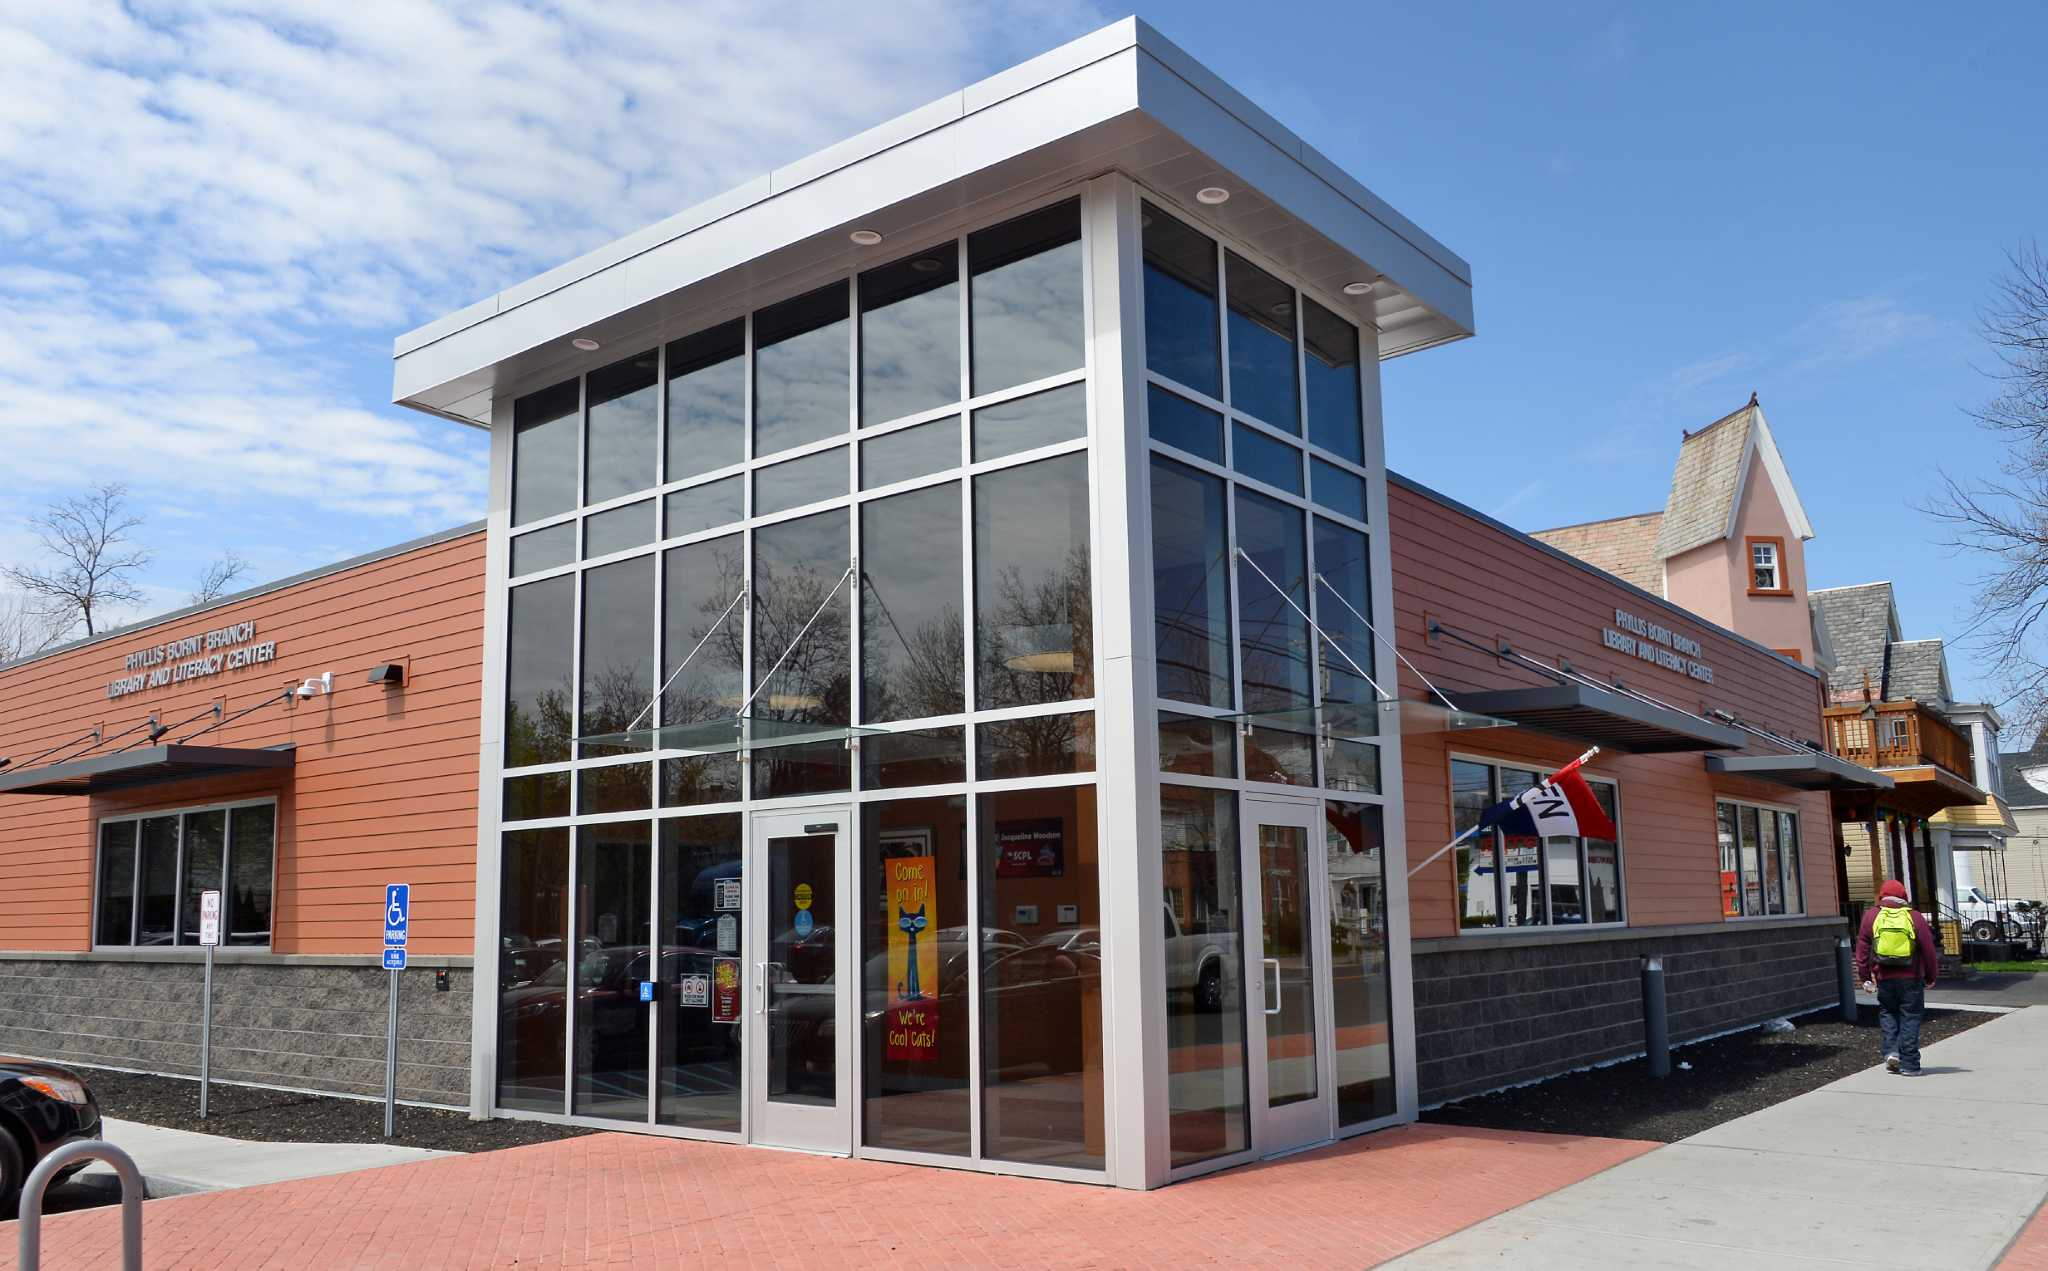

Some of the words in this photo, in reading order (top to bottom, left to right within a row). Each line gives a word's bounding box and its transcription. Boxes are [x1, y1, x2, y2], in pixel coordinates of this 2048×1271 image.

[1616, 609, 1647, 637] PHYLLIS
[1673, 633, 1701, 658] BRANCH
[125, 645, 165, 671] PHYLLIS
[167, 635, 203, 659] BORNT
[207, 620, 255, 648] BRANCH
[1603, 627, 1636, 656] LIBRARY
[1638, 641, 1655, 662] AND
[1656, 648, 1687, 674] LITERACY
[1687, 660, 1713, 684] CENTER
[106, 674, 146, 698] LIBRARY
[149, 667, 171, 687] AND
[175, 653, 224, 681] LITERACY
[228, 640, 276, 669] CENTER
[1013, 851, 1032, 860] SCPL
[895, 862, 924, 881] Come
[896, 888, 909, 902] on
[913, 879, 928, 902] in!
[386, 930, 406, 940] PARKING
[898, 1009, 926, 1026] We're
[889, 1028, 908, 1047] Cool
[911, 1029, 935, 1048] Cats!
